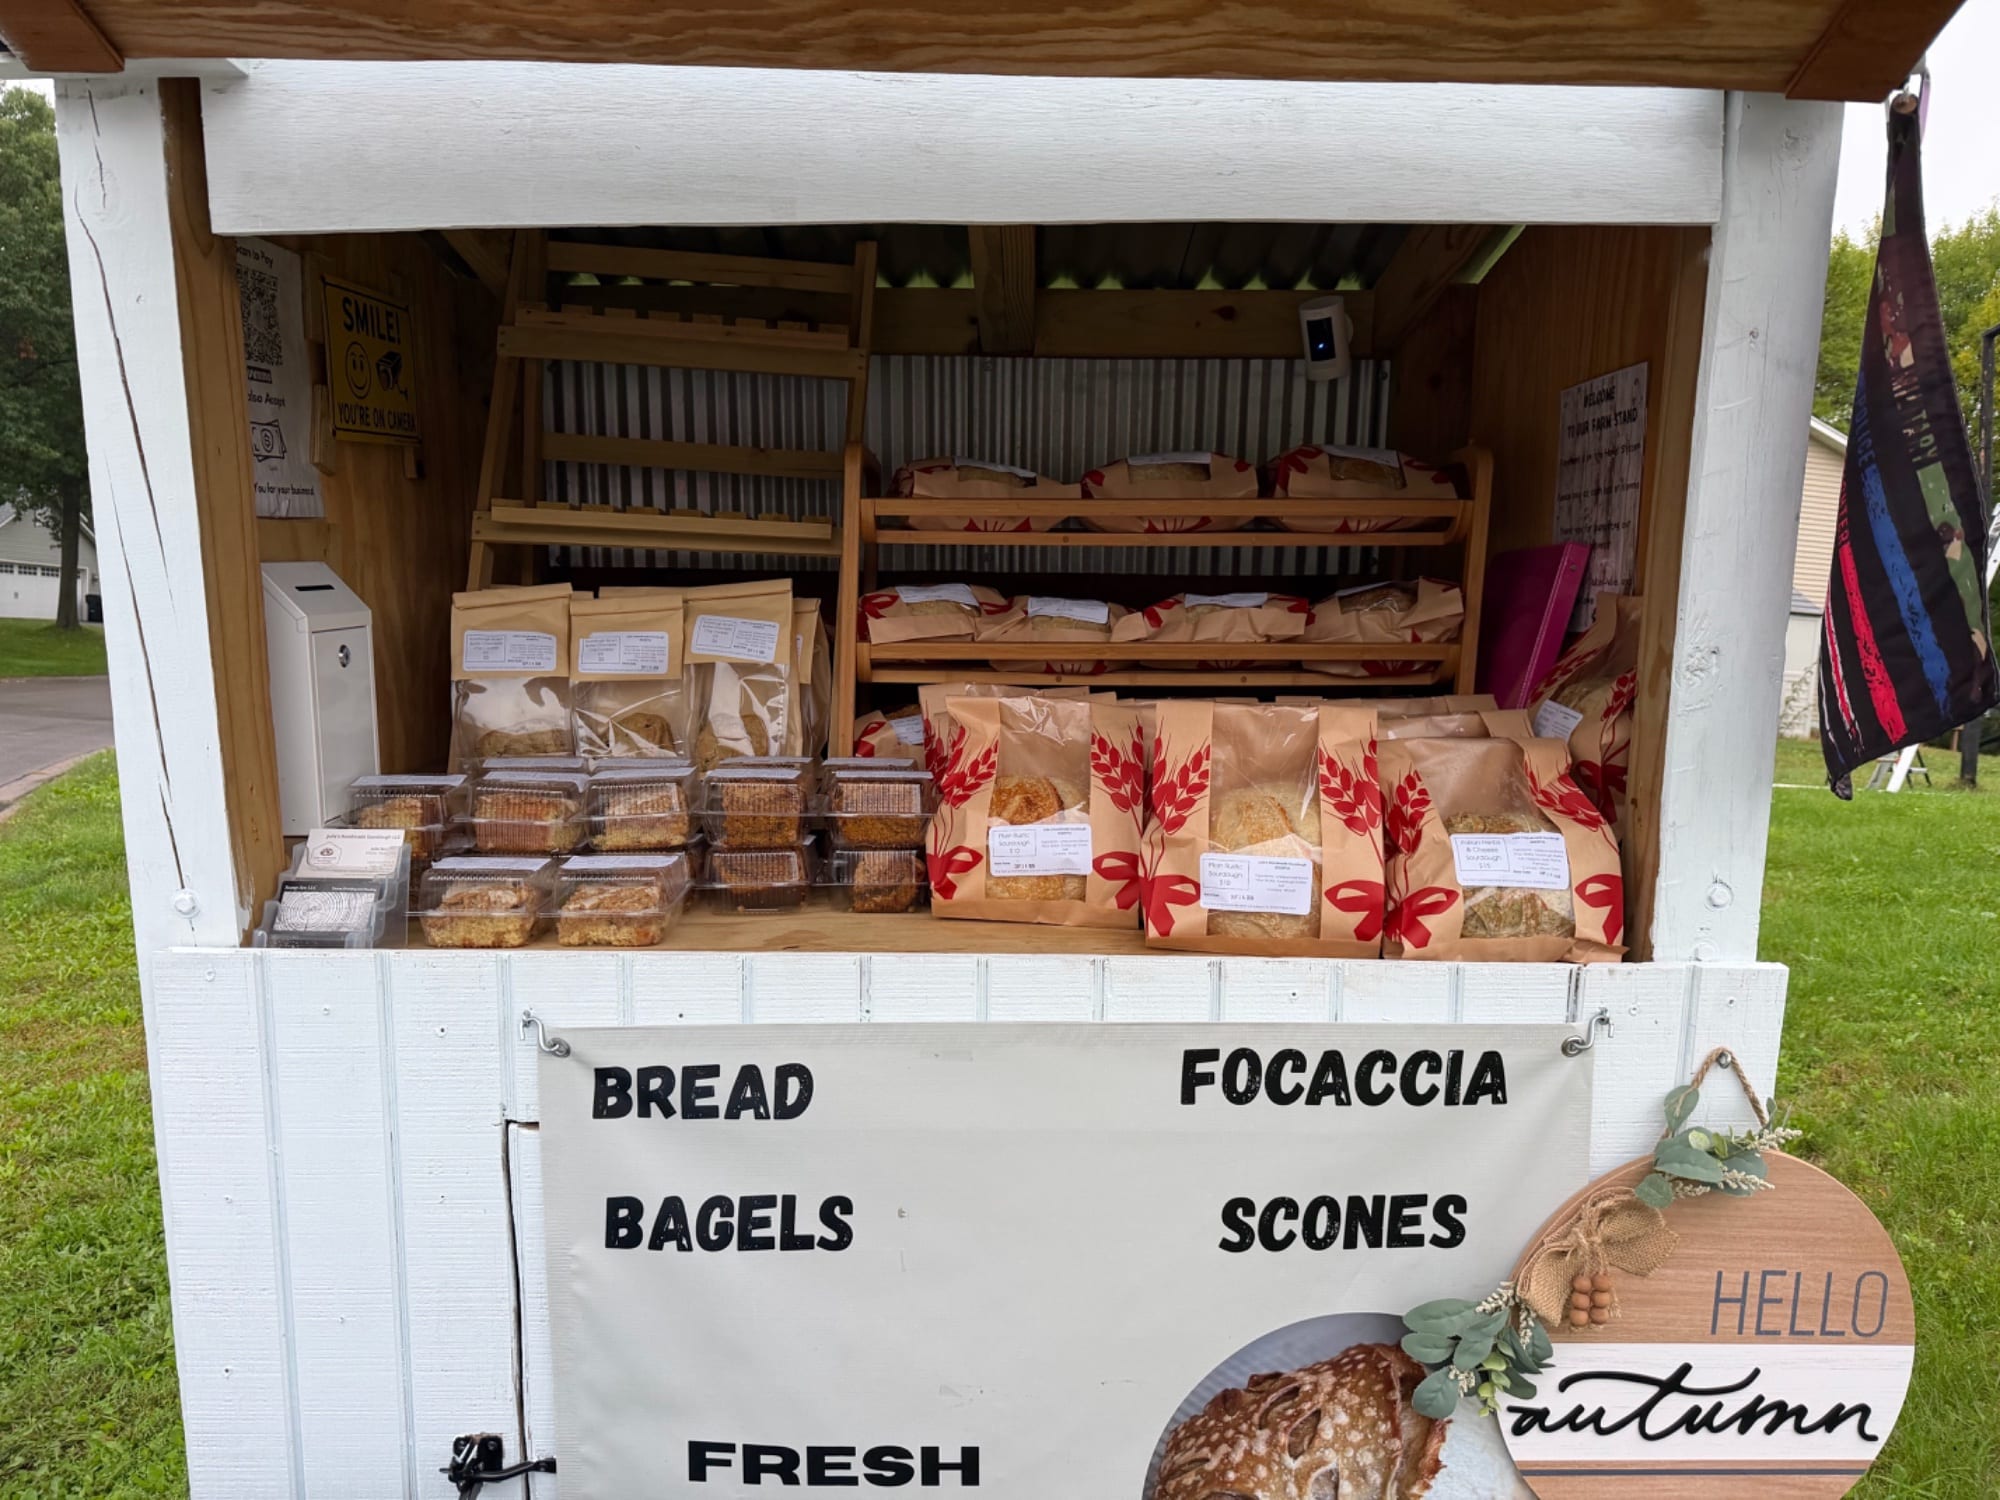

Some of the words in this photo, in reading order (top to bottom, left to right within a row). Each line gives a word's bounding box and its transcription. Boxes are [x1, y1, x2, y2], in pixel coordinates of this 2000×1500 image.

[342, 296, 401, 344] SMILE!
[338, 402, 371, 427] YOU'RE
[373, 407, 385, 428] ON
[387, 408, 416, 432] CAMERA
[1584, 386, 1615, 409] WELCOME
[1591, 415, 1612, 433] FARM
[1614, 408, 1637, 427] STAND
[999, 839, 1030, 848] Sourdough
[1465, 854, 1502, 863] Sourdough
[1208, 869, 1243, 879] Sourdough
[592, 1062, 814, 1120] BREAD
[1180, 1047, 1508, 1107] FOCACCIA
[605, 1194, 854, 1252] BAGELS
[1218, 1193, 1468, 1253] SCONES
[1710, 1270, 1889, 1338] HELLO
[1506, 1361, 1879, 1443] autumn
[687, 1440, 981, 1487] FRESH
